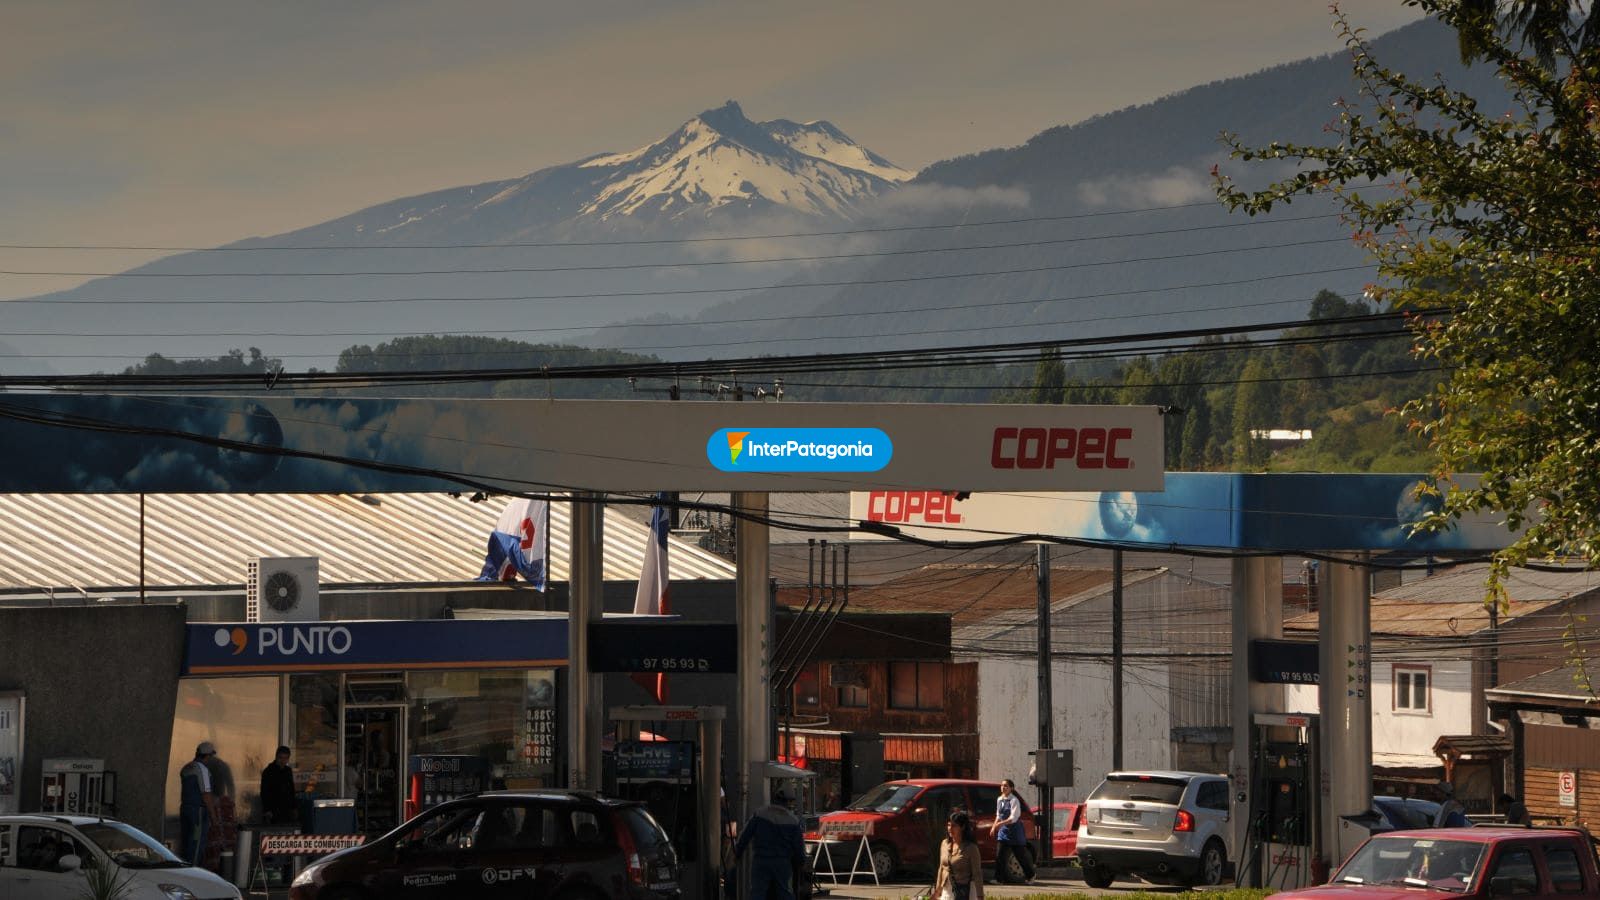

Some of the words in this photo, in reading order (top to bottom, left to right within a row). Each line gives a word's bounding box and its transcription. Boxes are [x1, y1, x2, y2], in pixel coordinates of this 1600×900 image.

[258, 626, 352, 655] PUNTO
[642, 658, 658, 669] 97
[661, 658, 677, 669] 95
[679, 658, 695, 669] 93
[420, 758, 461, 772] Mobil
[268, 839, 302, 849] DESCARGA
[303, 839, 313, 849] DE
[431, 873, 457, 883] Montt
